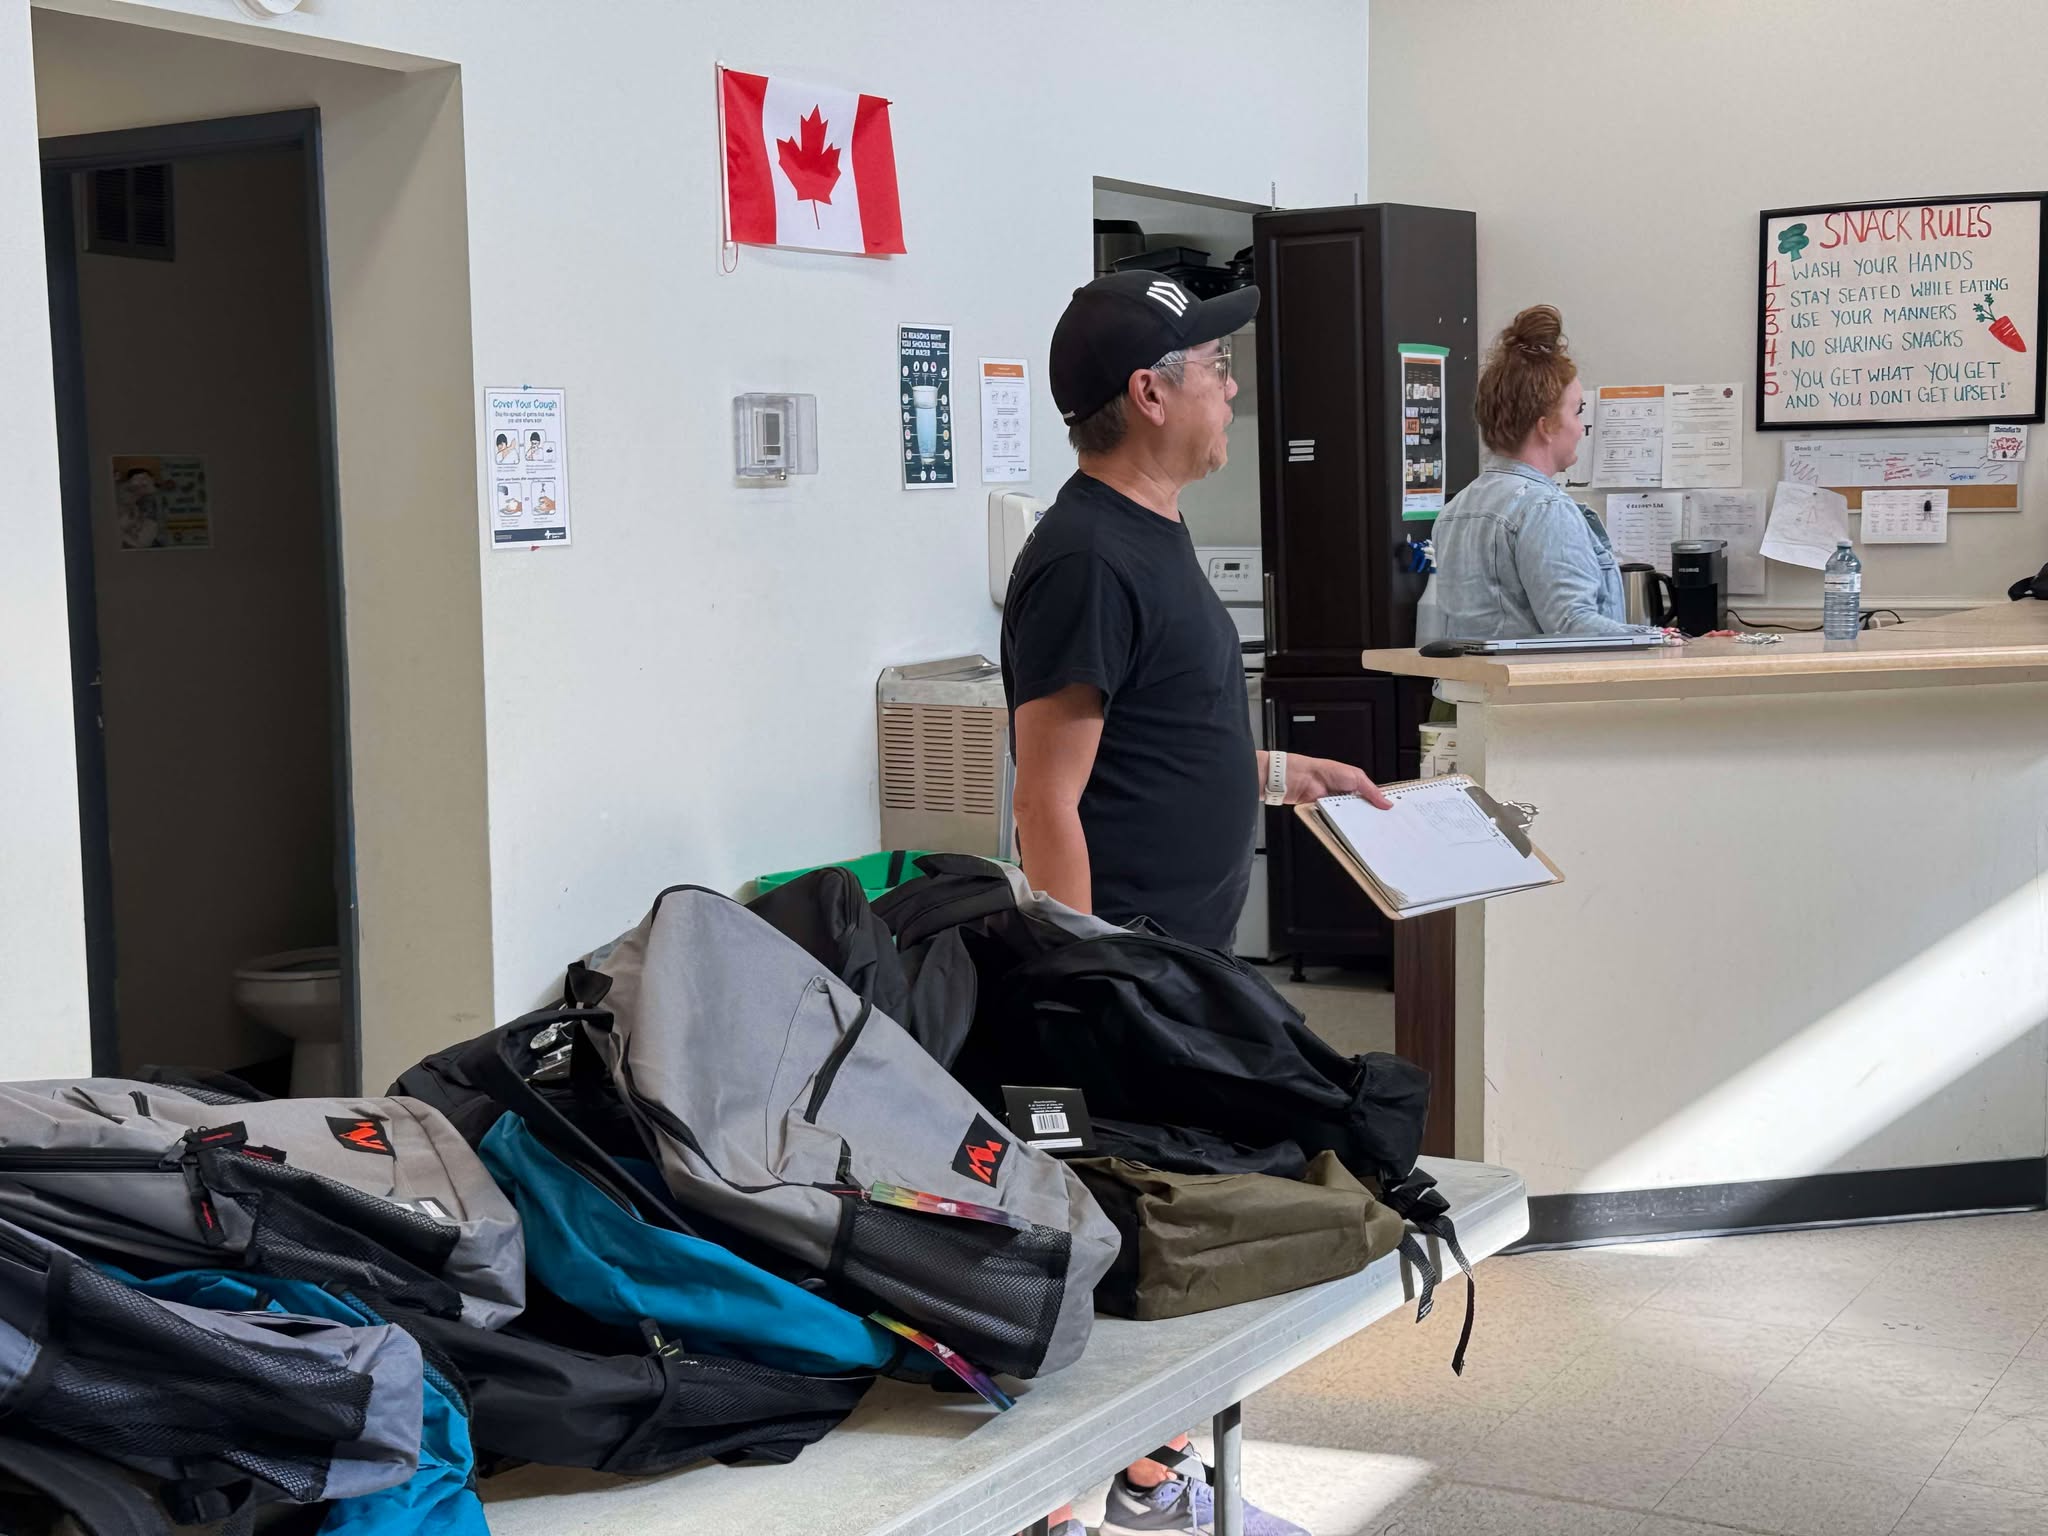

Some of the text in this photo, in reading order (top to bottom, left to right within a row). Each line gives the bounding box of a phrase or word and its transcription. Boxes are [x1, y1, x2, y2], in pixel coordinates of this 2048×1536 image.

[1820, 205, 1992, 249] SNACK RULES
[1791, 261, 1841, 281] WASH
[1853, 256, 1899, 277] YOUR
[1909, 250, 1974, 273] HANDS
[1790, 288, 1830, 307] STAY
[1839, 284, 1901, 304] SEATED
[1910, 280, 1953, 297] WHILE
[1960, 277, 2009, 294] EATING
[1791, 312, 1821, 328] USE
[1831, 308, 1873, 328] YOUR
[1884, 303, 1957, 324] MANNERS
[1791, 340, 1816, 359] NO
[1824, 333, 1893, 354] SHARING
[1902, 329, 1964, 351] SNACKS
[1791, 367, 1825, 391] YOU
[1831, 367, 1863, 386] GET
[1867, 366, 1915, 382] WHAT
[1923, 361, 1960, 384] YOU
[1964, 361, 2001, 379] GET
[492, 398, 558, 411] Cover Your Cough
[1785, 393, 1820, 409] AND
[1829, 391, 1862, 407] YOU
[1918, 386, 1949, 403] GET
[1954, 382, 2006, 402] UPSET!
